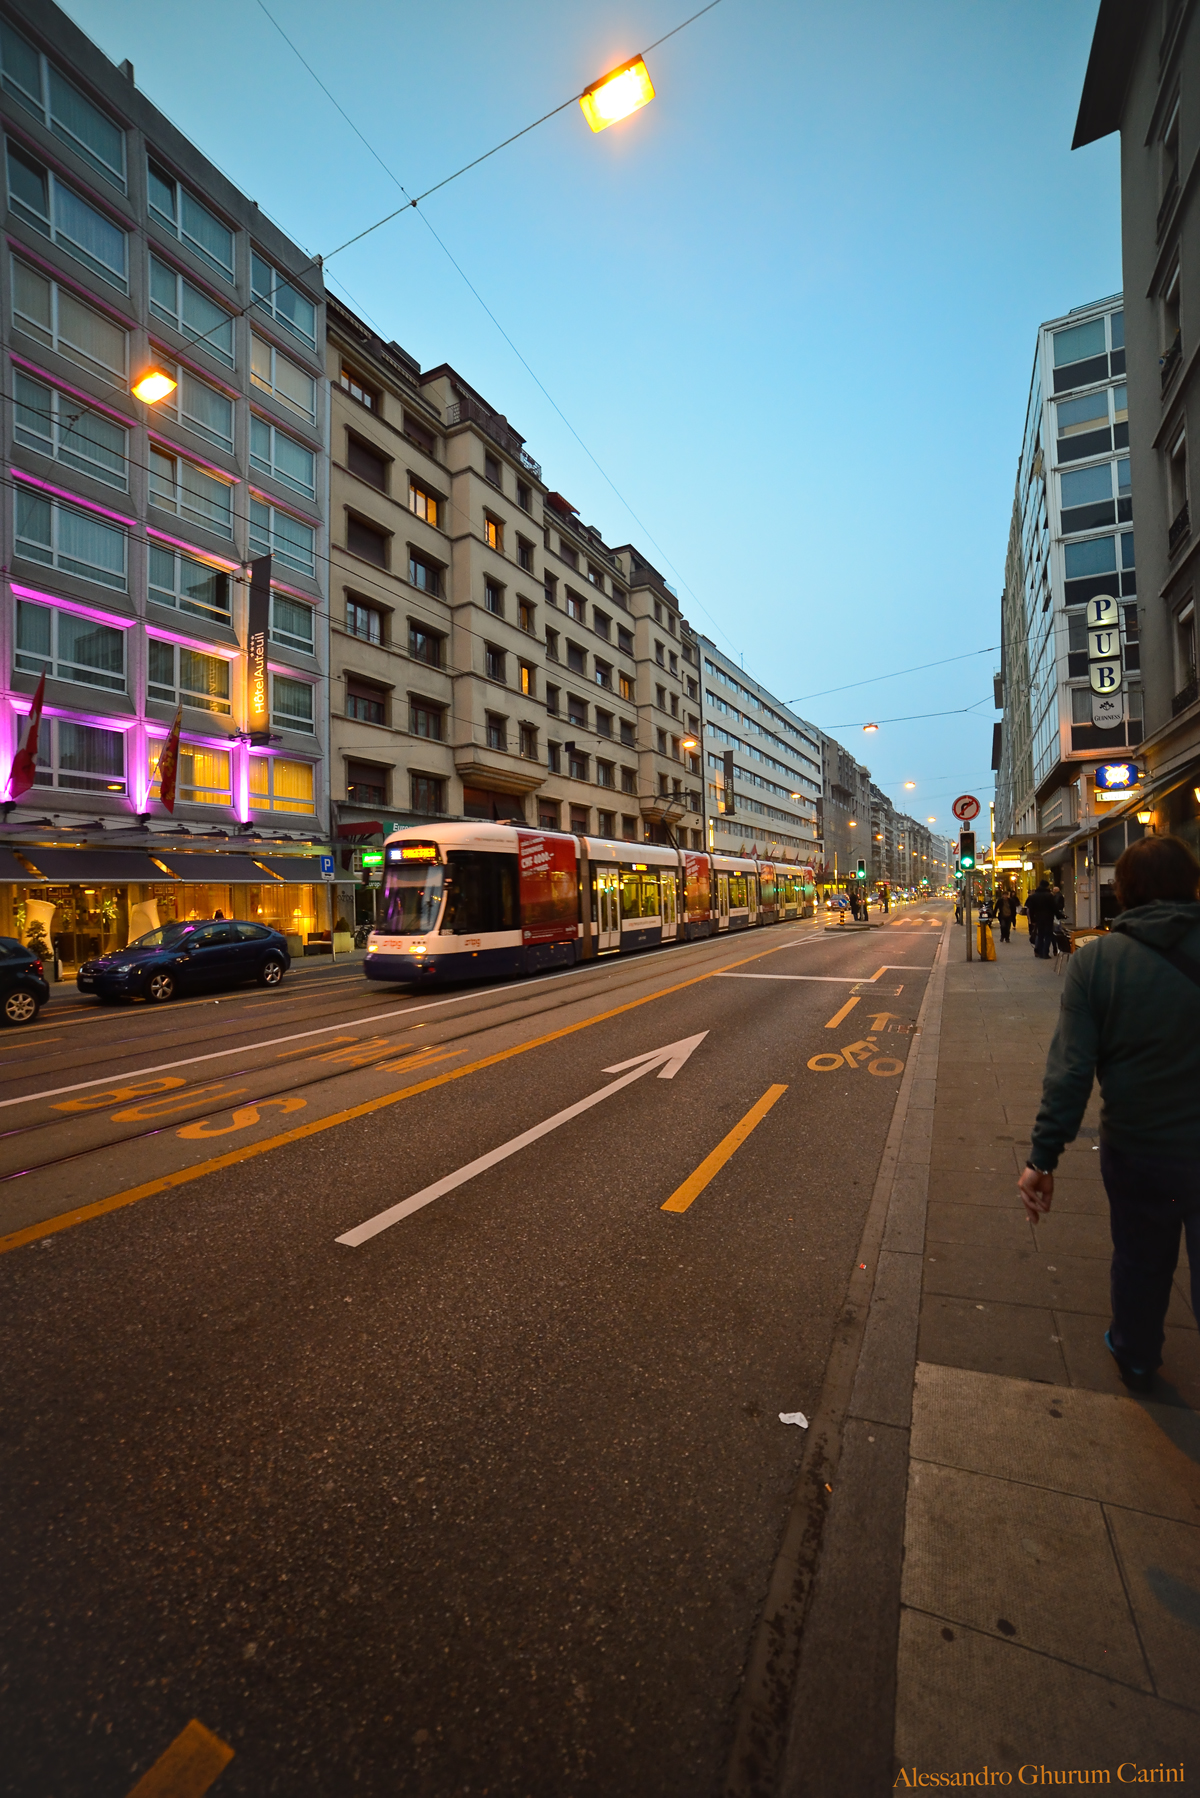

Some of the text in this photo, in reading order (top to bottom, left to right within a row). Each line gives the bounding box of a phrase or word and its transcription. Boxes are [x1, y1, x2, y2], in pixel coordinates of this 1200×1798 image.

[1092, 599, 1117, 689] PUB
[1094, 713, 1121, 722] GUINNESS
[324, 858, 331, 871] P
[521, 856, 533, 869] CHF
[276, 1036, 469, 1074] TRAM
[49, 1076, 307, 1139] BUS
